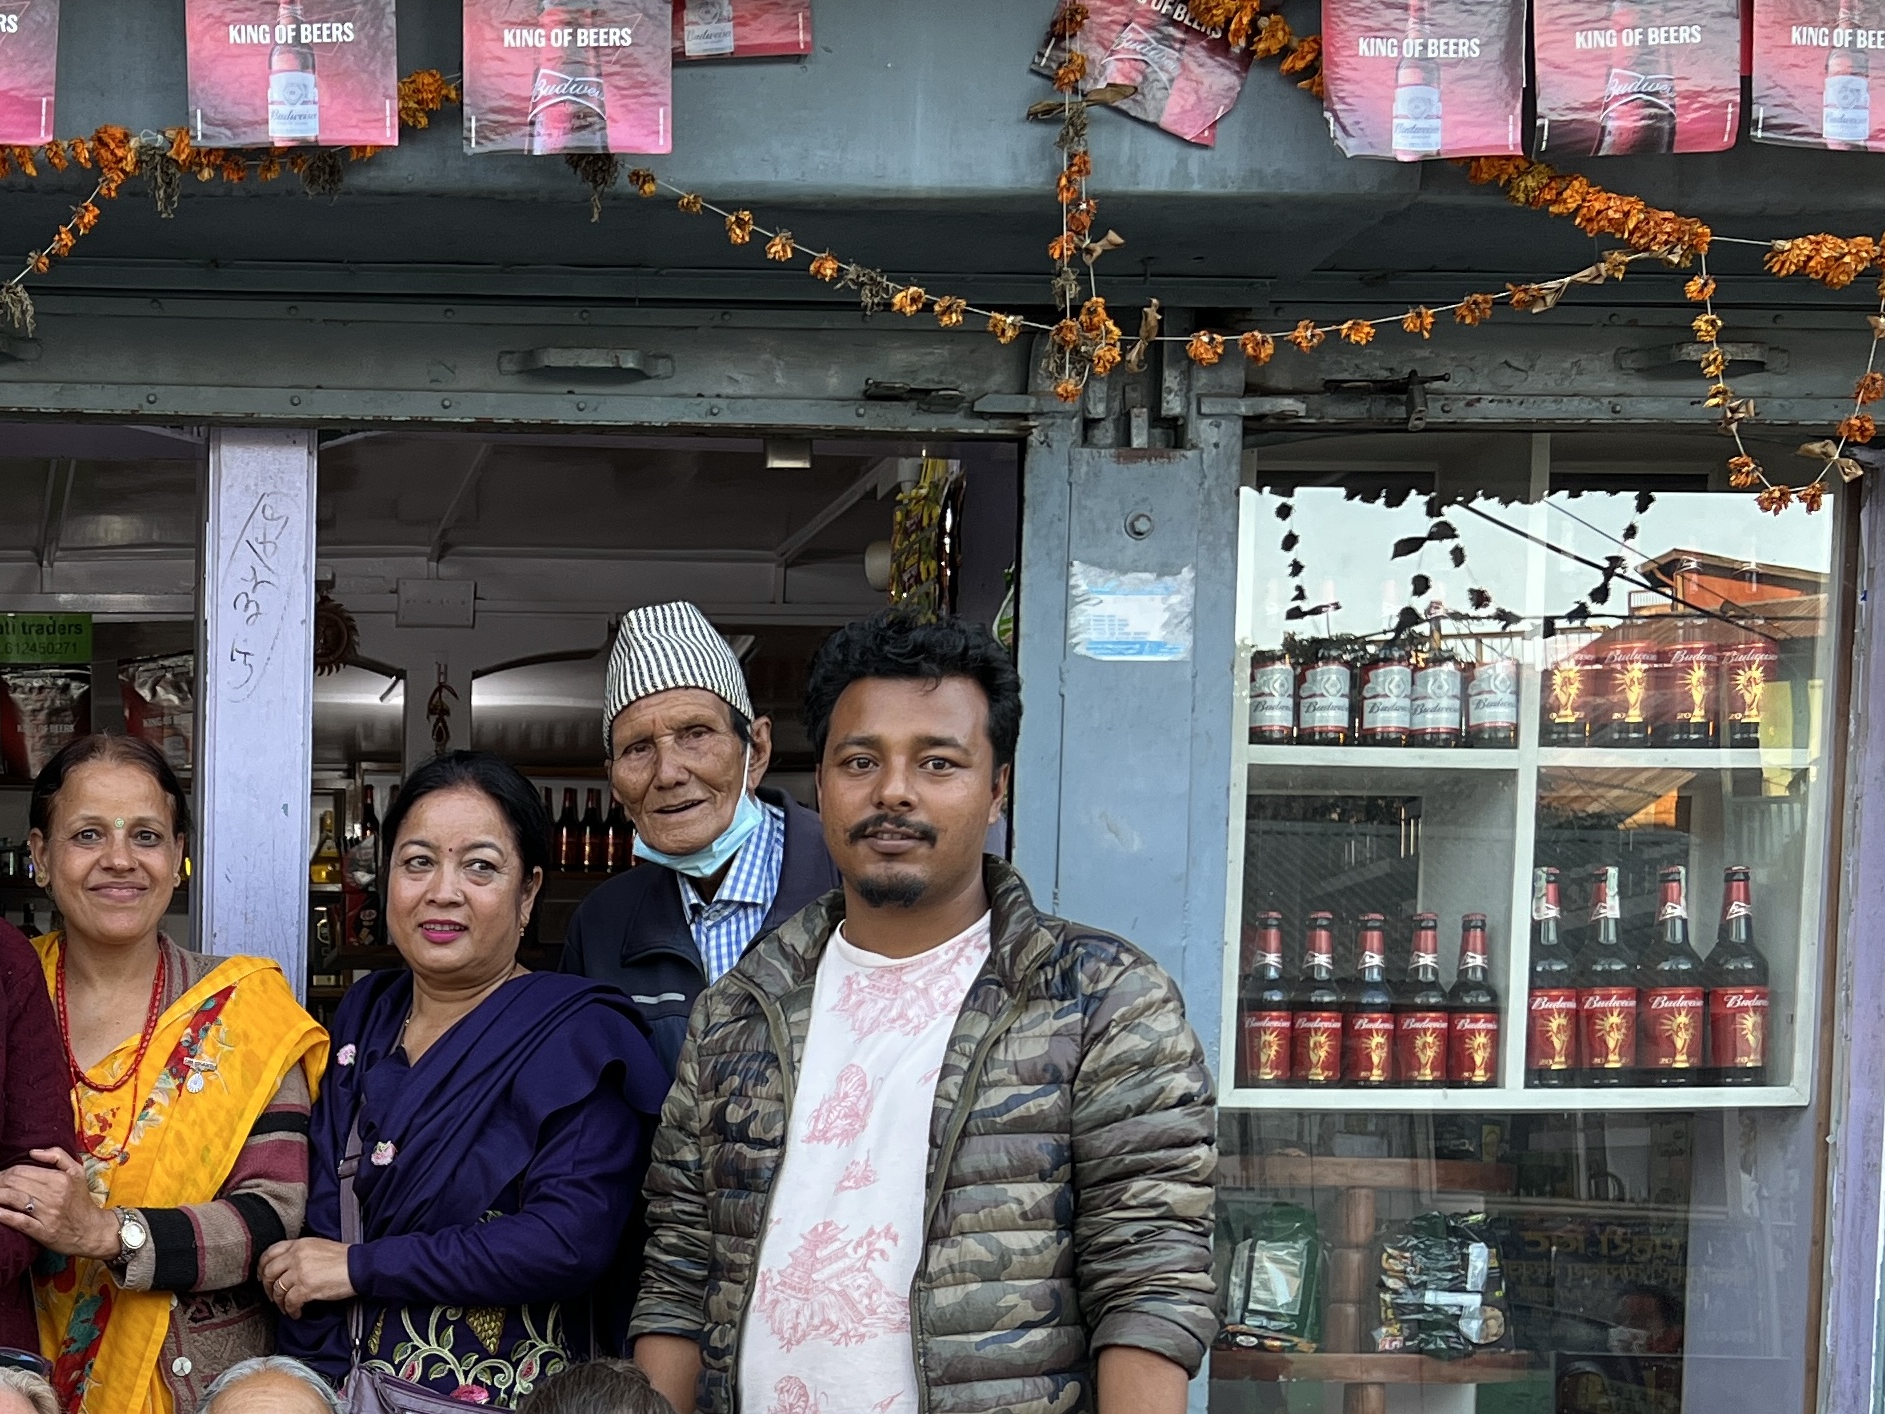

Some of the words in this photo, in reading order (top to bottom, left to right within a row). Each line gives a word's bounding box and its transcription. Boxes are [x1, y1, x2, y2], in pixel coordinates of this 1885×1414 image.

[229, 24, 271, 44] KING
[274, 24, 297, 44] OF
[300, 22, 355, 44] BEERS
[503, 28, 546, 48] KING
[551, 28, 573, 47] OF
[577, 27, 633, 48] BEERS
[1575, 30, 1617, 49] KING
[1622, 28, 1644, 47] OF
[1647, 25, 1702, 46] BEERS
[1791, 26, 1830, 47] KING
[1833, 28, 1854, 48] OF
[1358, 36, 1399, 57] KING
[1402, 38, 1424, 58] OF
[1427, 38, 1481, 58] BEERS
[21, 620, 83, 636] traders
